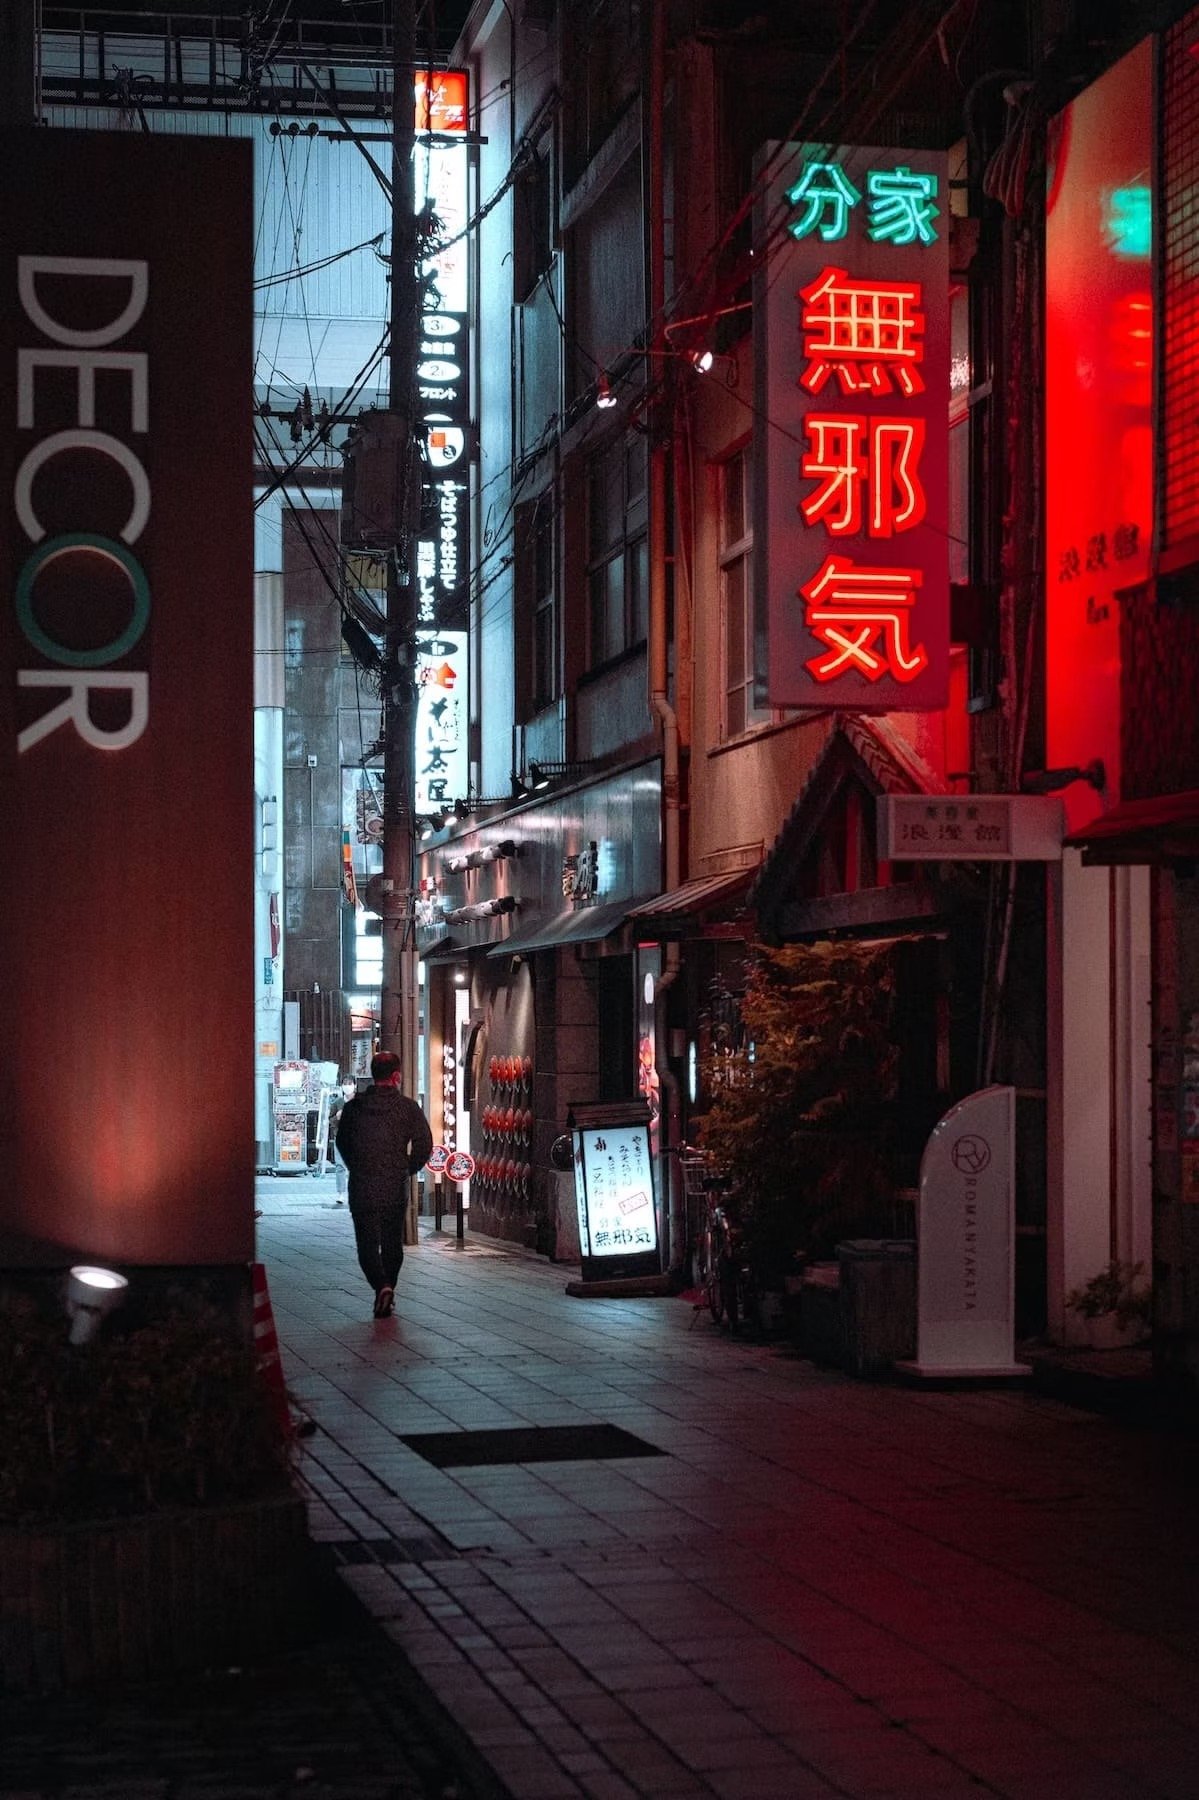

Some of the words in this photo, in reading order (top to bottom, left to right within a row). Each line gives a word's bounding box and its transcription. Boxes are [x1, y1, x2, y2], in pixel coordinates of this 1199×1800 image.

[785, 162, 940, 247] 分家
[419, 387, 457, 400] フロント
[15, 255, 151, 753] DECOR
[799, 265, 928, 686] 無邪気
[421, 697, 458, 803] そば茶屋
[594, 1226, 651, 1248] 無邪気
[964, 1177, 977, 1310] ROMANYAKATA
